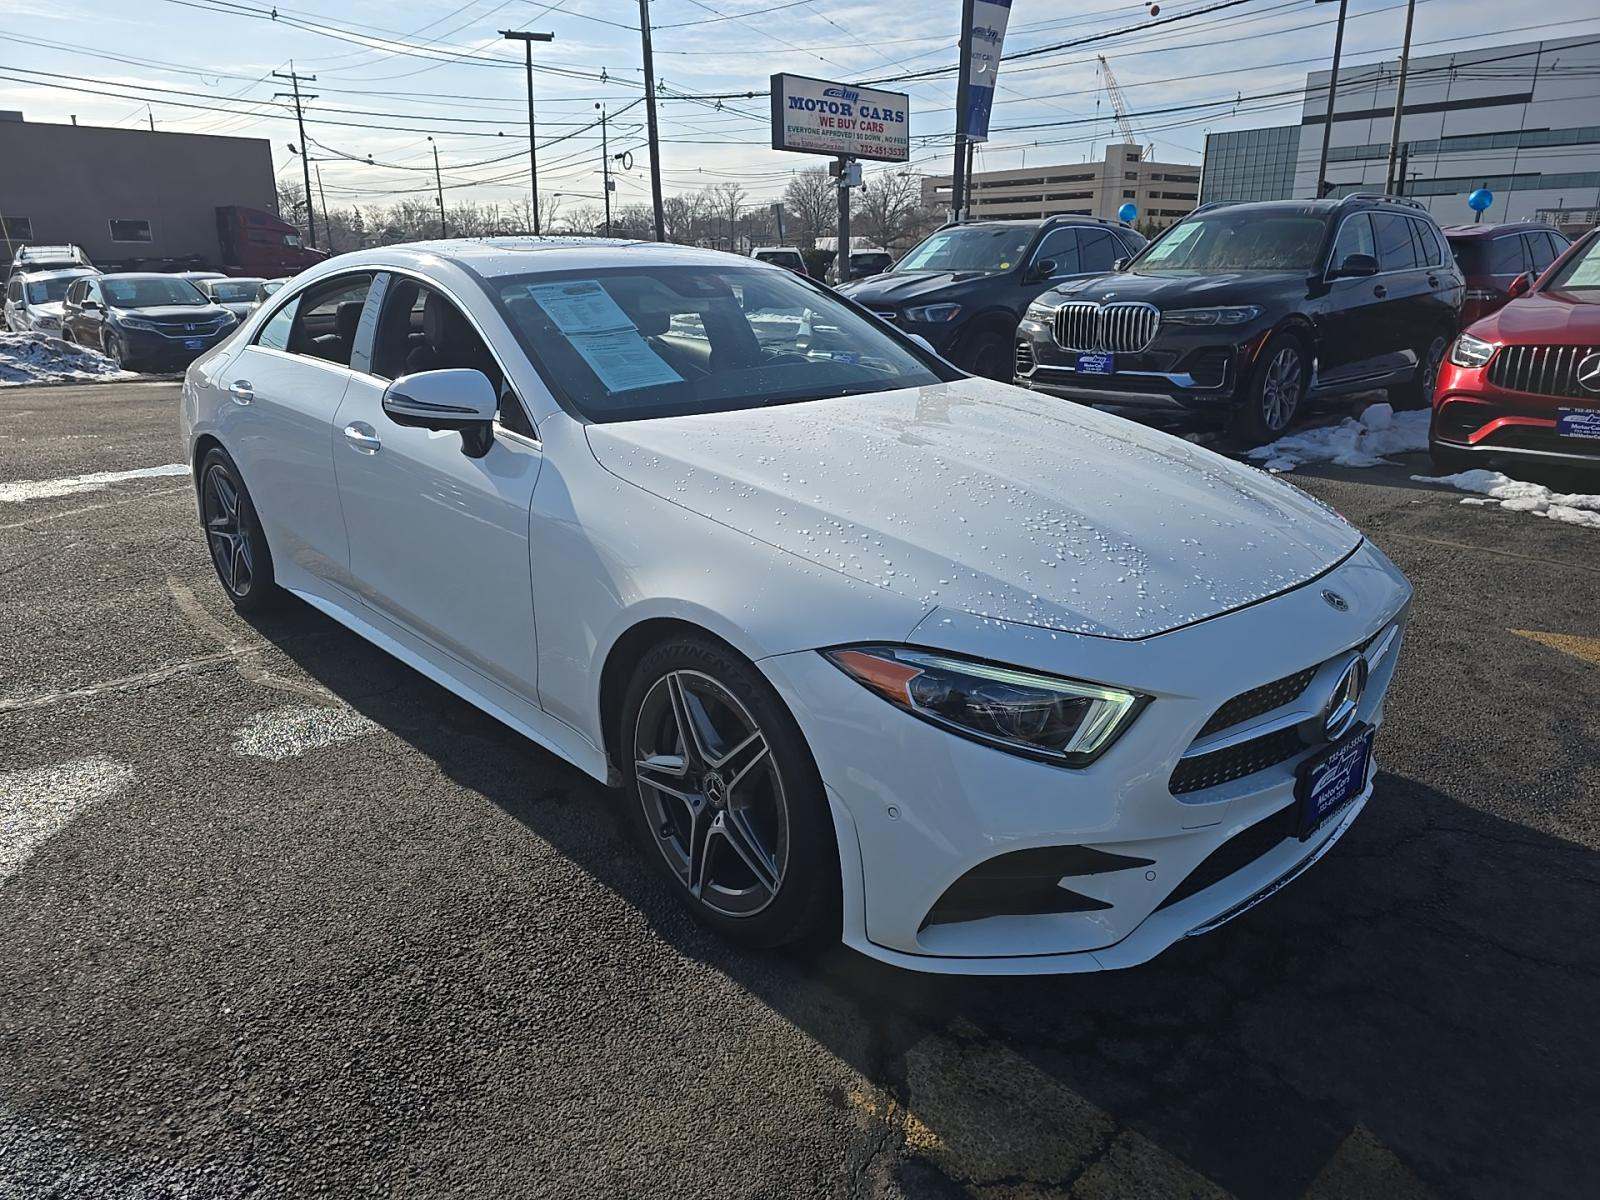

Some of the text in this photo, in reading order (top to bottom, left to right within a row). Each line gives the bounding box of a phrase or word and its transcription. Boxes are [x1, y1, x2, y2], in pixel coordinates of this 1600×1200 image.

[788, 96, 904, 123] MOTOR CARS
[787, 125, 820, 135] EVERYONE
[820, 116, 884, 134] WE BUY CARS
